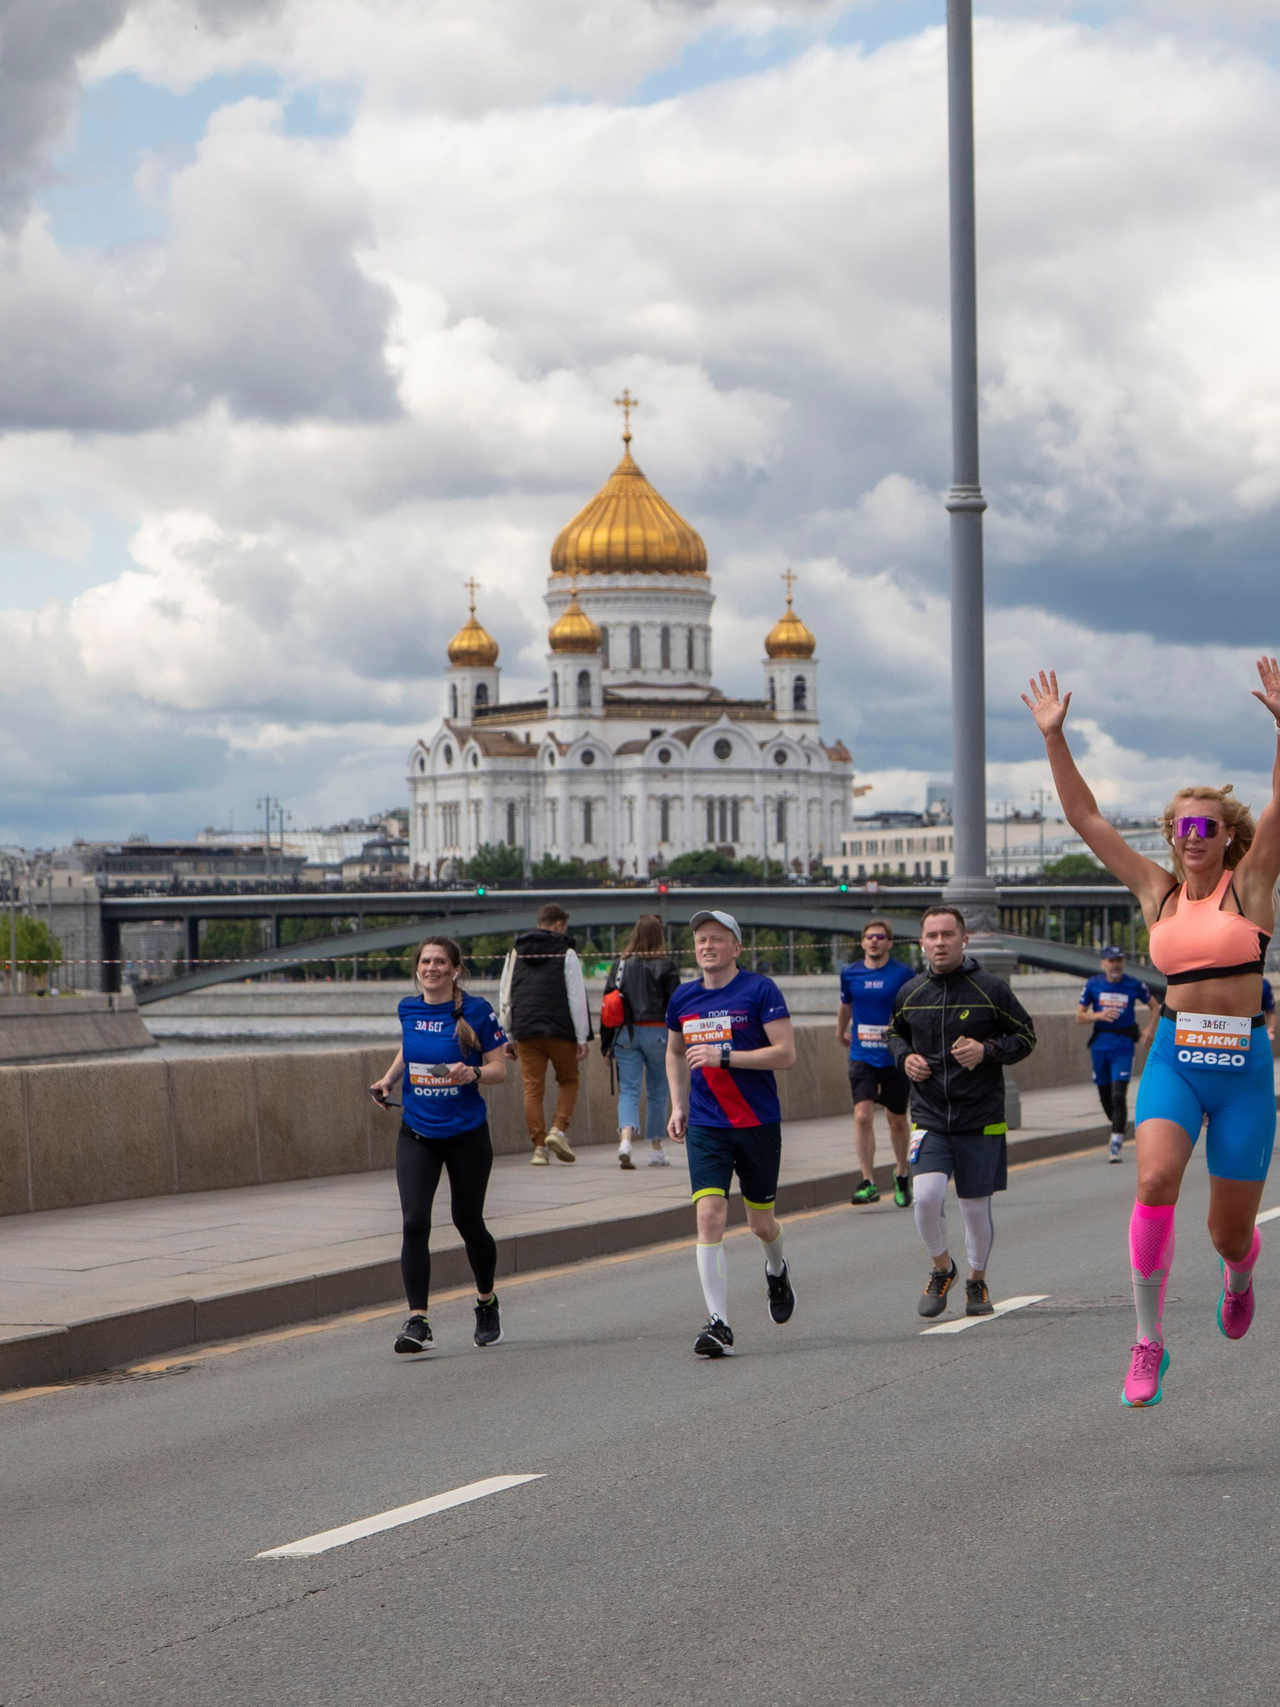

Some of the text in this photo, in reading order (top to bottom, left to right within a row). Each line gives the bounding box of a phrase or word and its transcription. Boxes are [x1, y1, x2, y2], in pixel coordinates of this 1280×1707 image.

[1186, 1033, 1239, 1047] 21,1КМ
[1178, 1050, 1246, 1067] 02620
[414, 1087, 458, 1096] 00775
